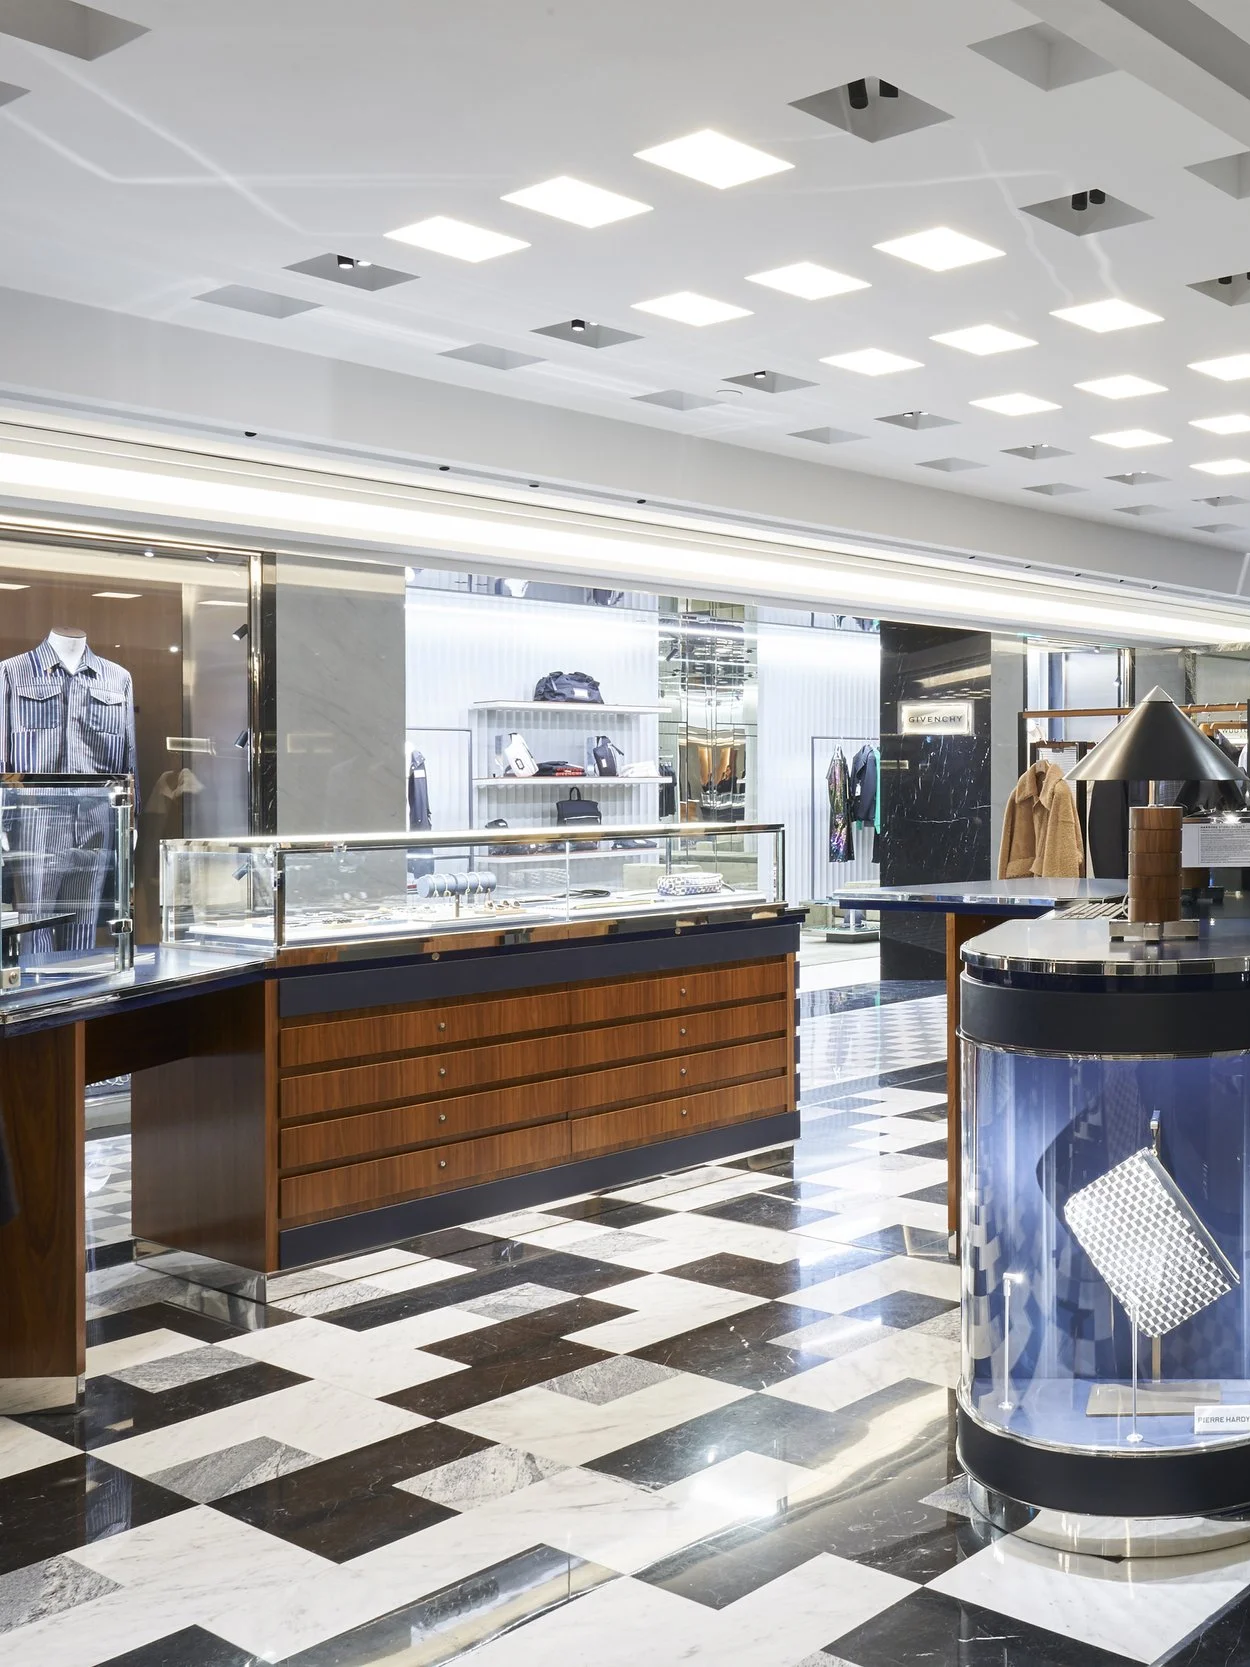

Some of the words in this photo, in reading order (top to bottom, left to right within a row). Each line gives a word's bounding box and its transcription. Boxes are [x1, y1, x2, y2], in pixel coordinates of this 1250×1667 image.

[908, 715, 963, 724] GIVENCHY
[1198, 1416, 1225, 1424] PIERRE
[1226, 1415, 1250, 1423] HARDY
